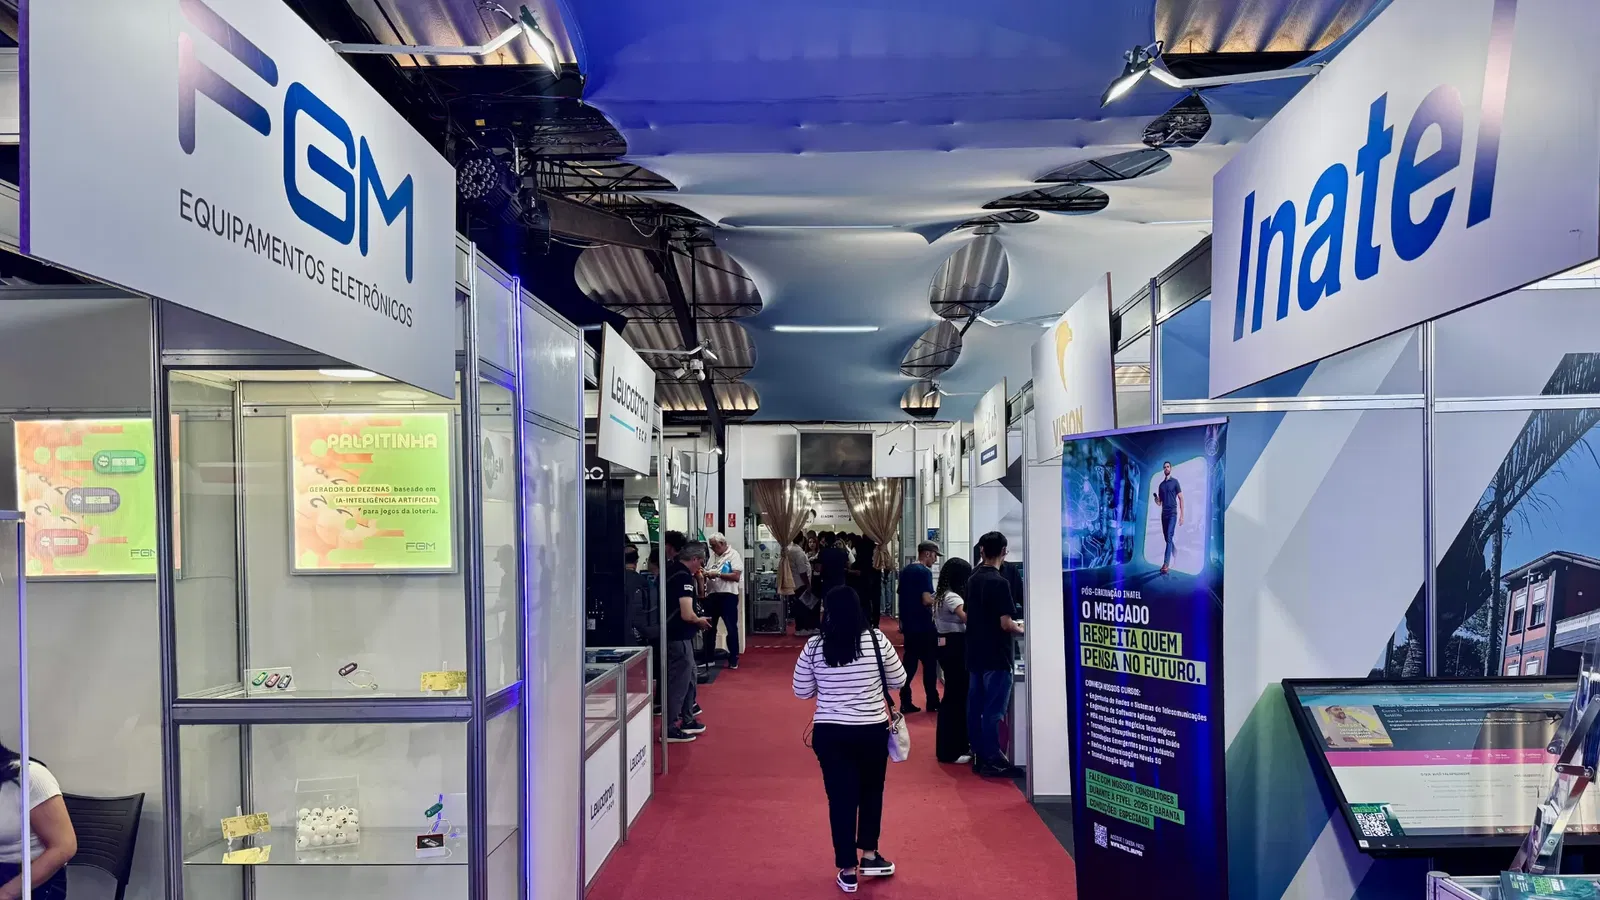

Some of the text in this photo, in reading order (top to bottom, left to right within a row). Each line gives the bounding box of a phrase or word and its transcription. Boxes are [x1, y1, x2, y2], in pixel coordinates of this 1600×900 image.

[178, 0, 413, 283] FGM
[1233, 0, 1518, 343] Inatel
[179, 188, 413, 329] EQUIPAMENTOS ELETRÔNICOS
[611, 366, 649, 423] Leucotron
[635, 426, 647, 443] TECH
[1052, 405, 1083, 447] VISION
[327, 433, 438, 449] PALPITINHA
[335, 495, 397, 504] IA-INTELIGÊNCIA
[362, 508, 379, 516] para
[380, 508, 400, 516] jogos
[405, 542, 436, 550] FGM
[1081, 586, 1142, 600] PÓS-GRADUAÇÃO INATEL
[1081, 601, 1150, 625] O MERCADO
[1083, 624, 1178, 653] RESPEITA QUEM
[1084, 647, 1201, 683] PENSA NO FUTURO.
[1103, 683, 1120, 693] NOSSOS
[1121, 686, 1141, 696] CURSOS:
[1109, 706, 1115, 714] de
[1115, 708, 1137, 718] Software
[1137, 712, 1156, 723] Aplicada
[1115, 698, 1130, 707] Redes
[1134, 701, 1154, 712] Sistemas
[1155, 704, 1161, 712] de
[1162, 706, 1207, 722] Telecomunicações
[1111, 727, 1137, 739] Disruptivas
[1140, 733, 1157, 743] Gestão
[1165, 739, 1180, 748] Saúde
[1125, 719, 1145, 731] Negócios
[1145, 724, 1176, 737] Tecnológicos
[1107, 746, 1139, 759] Comunicações
[1112, 737, 1138, 749] Emergentes
[1138, 744, 1148, 752] para
[1153, 746, 1175, 758] Indústria
[1119, 757, 1134, 768] Digital
[1089, 772, 1174, 805] FALE COM NOSSOS CONSULTORES
[590, 783, 614, 820] Leucotron
[1089, 785, 1110, 799] DURANTE
[1110, 793, 1116, 801] A
[1133, 800, 1149, 811] 2025
[1149, 805, 1154, 813] E
[1154, 806, 1181, 822] GARANTA
[1089, 798, 1150, 826] CONDIÇÕES ESPECIAIS!
